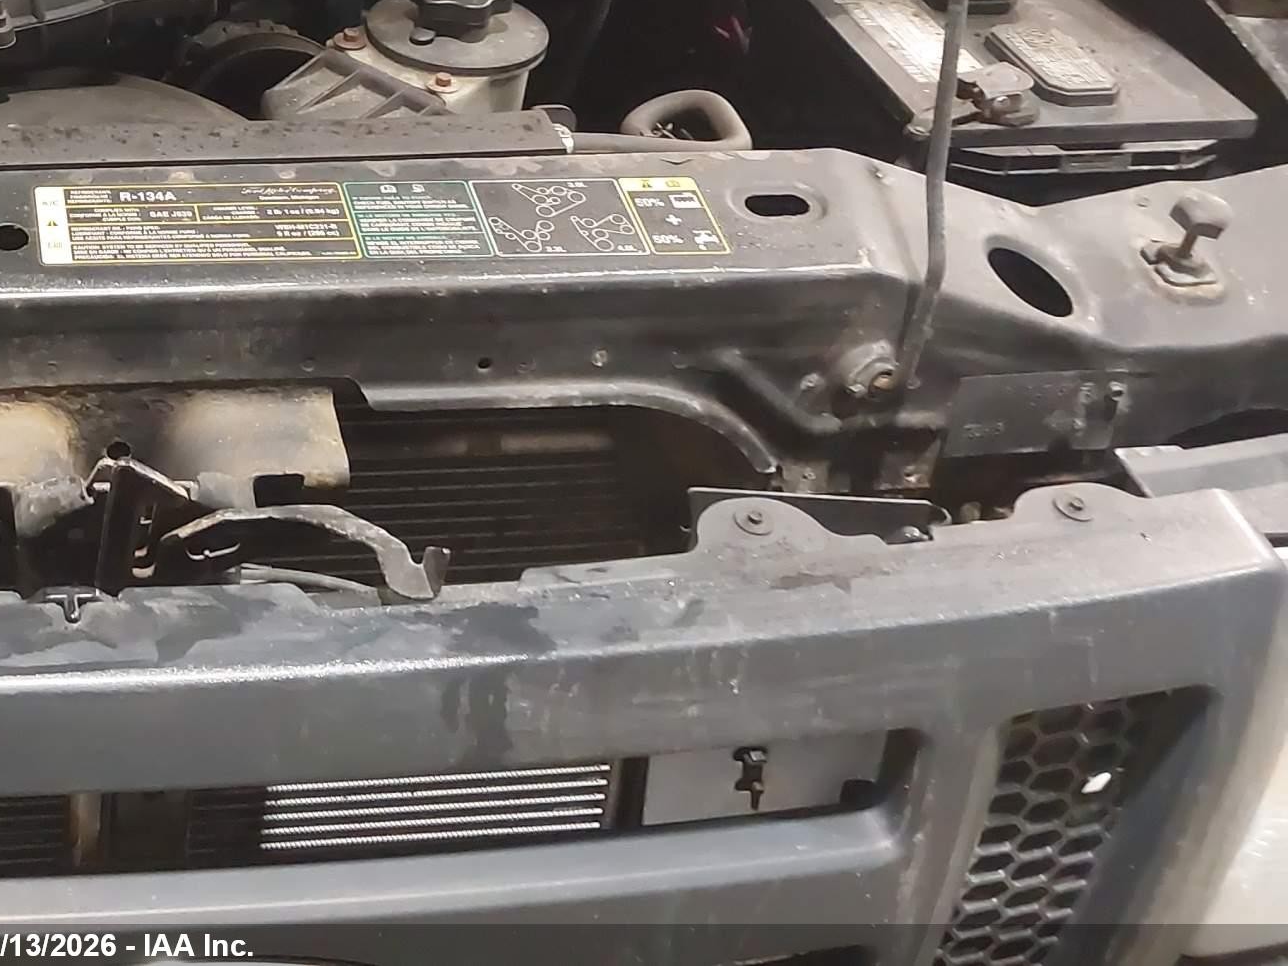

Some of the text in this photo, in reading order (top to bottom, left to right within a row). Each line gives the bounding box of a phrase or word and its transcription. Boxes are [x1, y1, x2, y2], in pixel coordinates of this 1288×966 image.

[119, 191, 177, 202] R-134A
[634, 198, 665, 208] 50%
[652, 234, 684, 244] 50%
